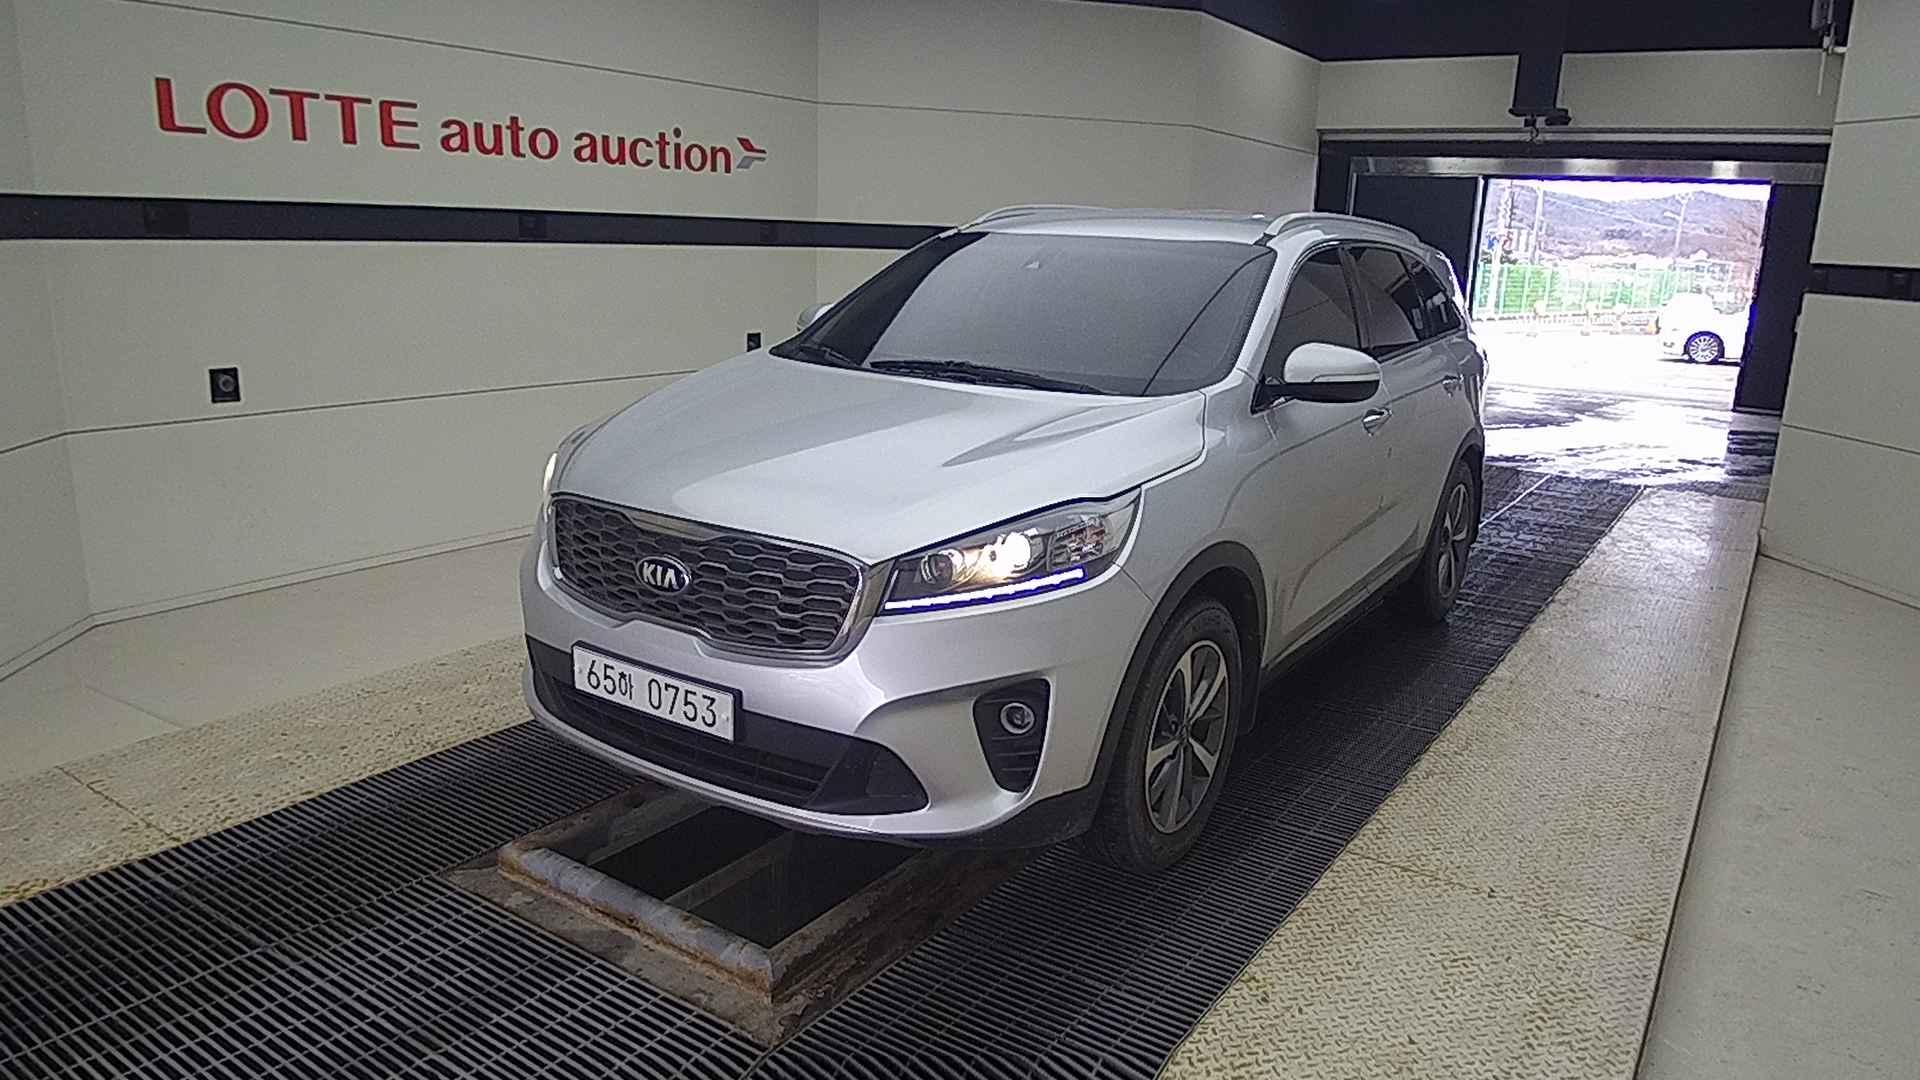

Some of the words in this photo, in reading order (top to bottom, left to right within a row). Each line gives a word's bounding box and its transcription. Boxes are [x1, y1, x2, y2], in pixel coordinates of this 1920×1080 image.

[154, 76, 420, 150] LOTTE
[439, 115, 559, 159] auto
[572, 126, 732, 174] auction
[642, 561, 679, 590] KIA
[586, 659, 634, 701] 65하
[647, 678, 717, 729] 0753
